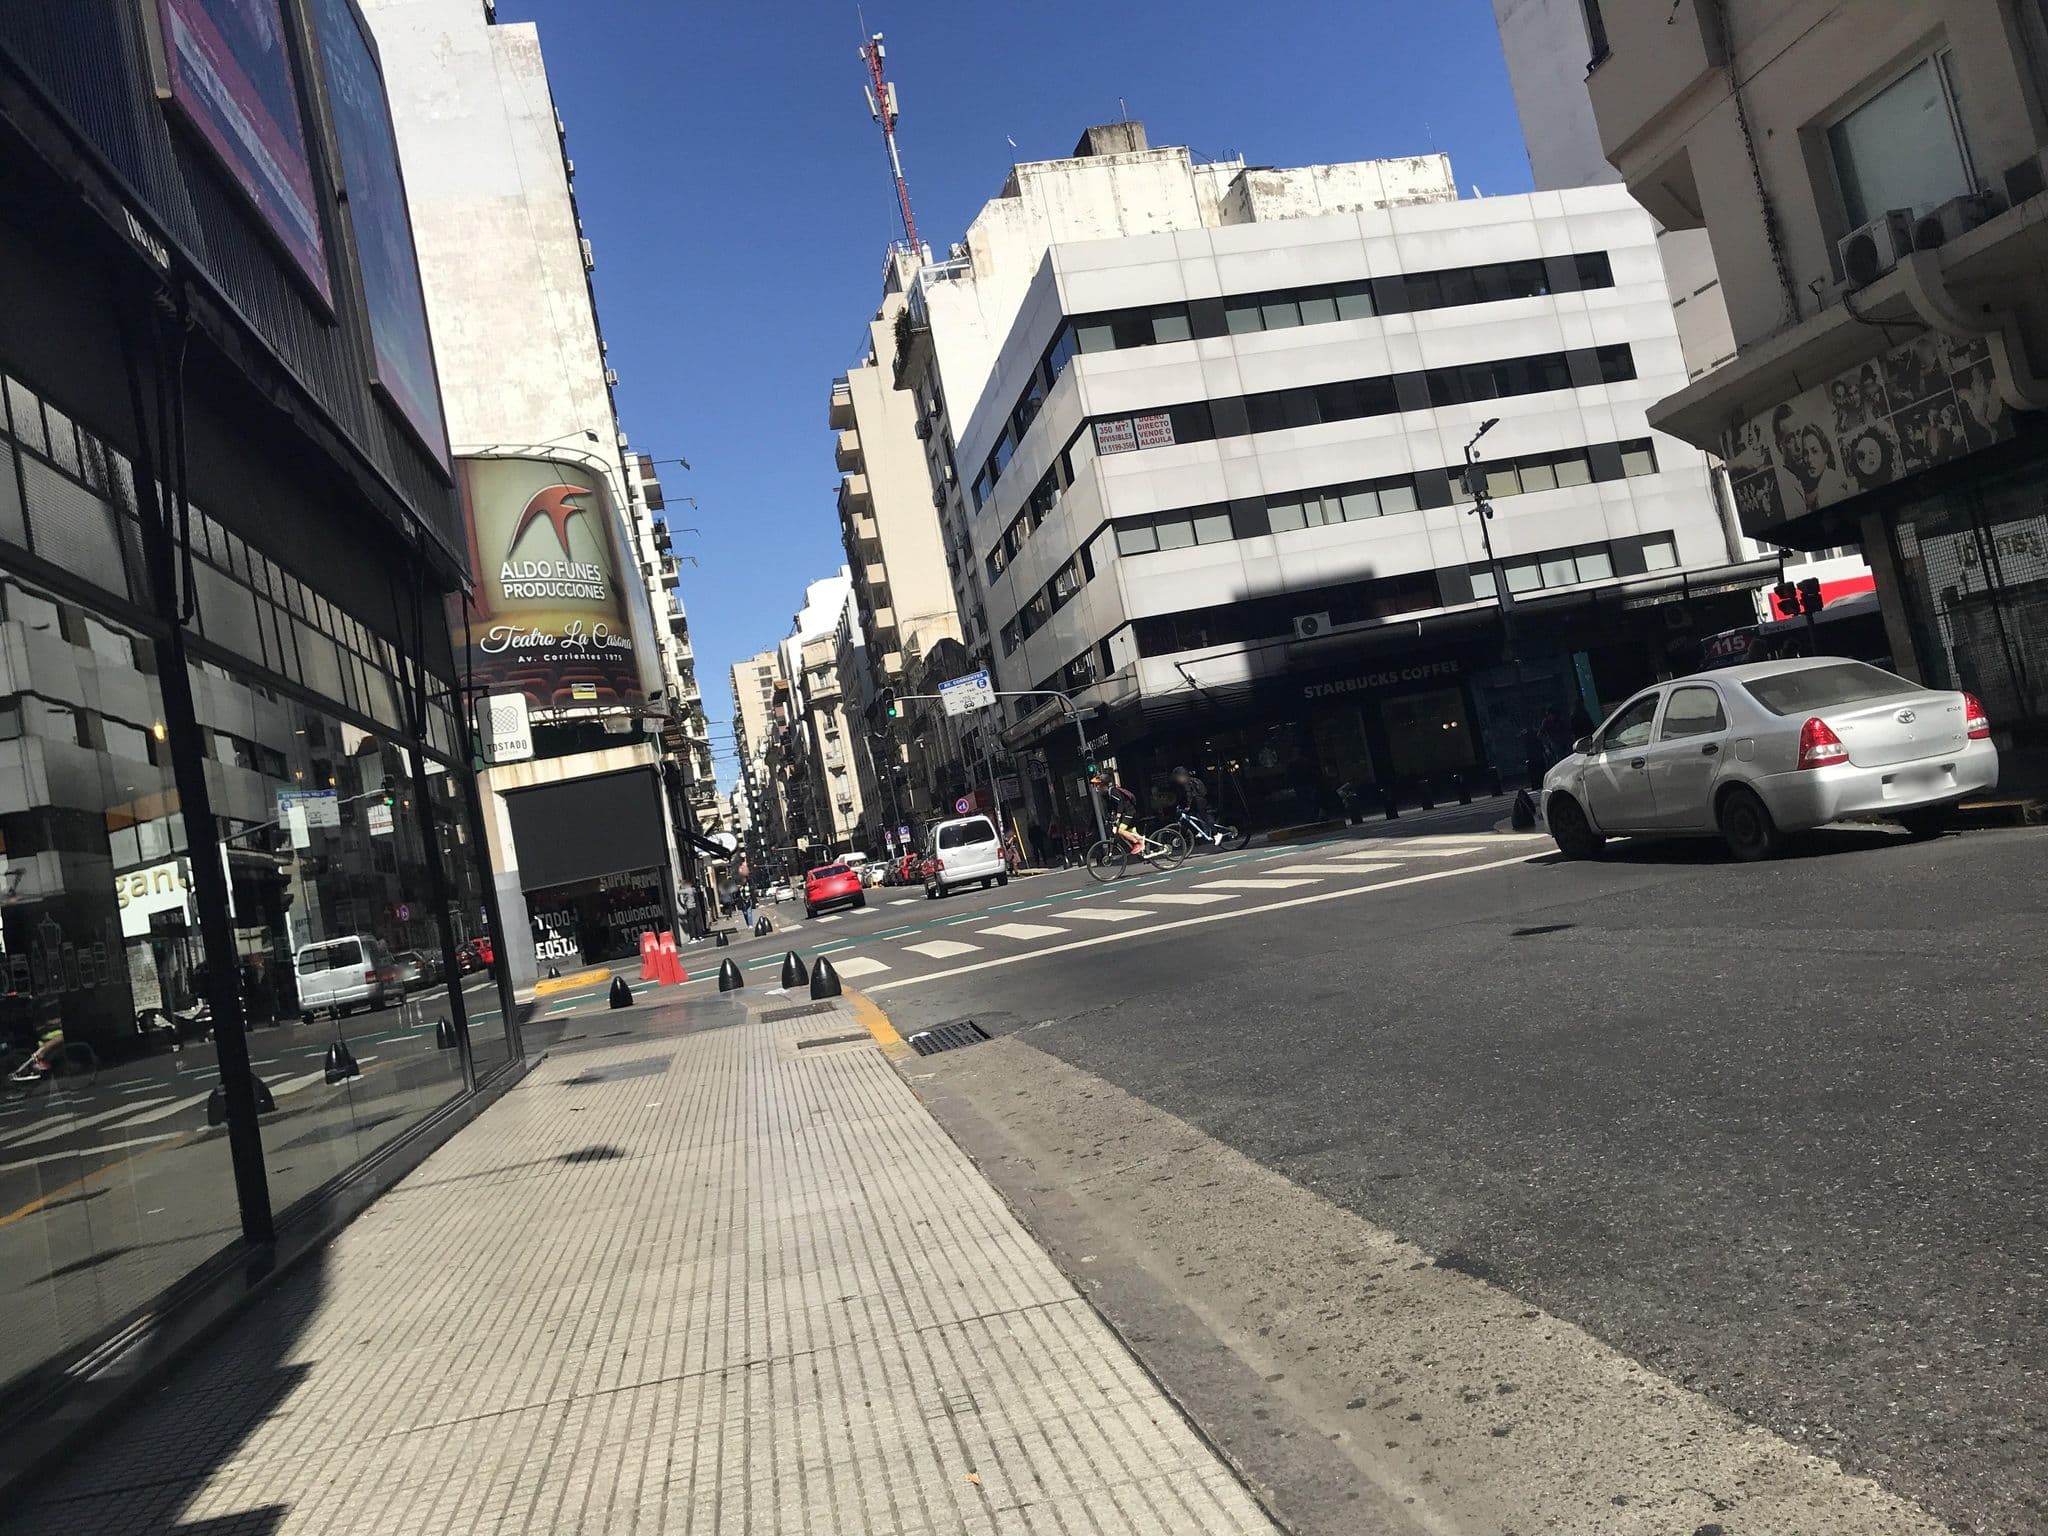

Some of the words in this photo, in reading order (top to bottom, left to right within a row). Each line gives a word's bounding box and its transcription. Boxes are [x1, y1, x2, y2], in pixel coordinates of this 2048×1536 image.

[1099, 426, 1113, 434] 350
[1136, 421, 1169, 431] DIRECTO
[1099, 433, 1133, 443] DIVISIBLES
[1138, 430, 1164, 438] VENDE
[1140, 436, 1172, 446] ALQUILA
[500, 560, 552, 580] ALDO
[555, 560, 601, 581] FUNES
[503, 582, 605, 600] PRODUCCIONES
[480, 625, 557, 653] Teatro
[560, 620, 590, 653] La
[1712, 635, 1746, 654] 115
[517, 655, 537, 664] Av.
[543, 653, 601, 662] Corrientes
[1303, 671, 1399, 698] STARBUCKS
[1400, 660, 1460, 681] COFFEE
[486, 739, 528, 754] TOSTADO
[600, 872, 631, 889] SUPER
[534, 910, 571, 930] TODO
[549, 929, 562, 939] AL
